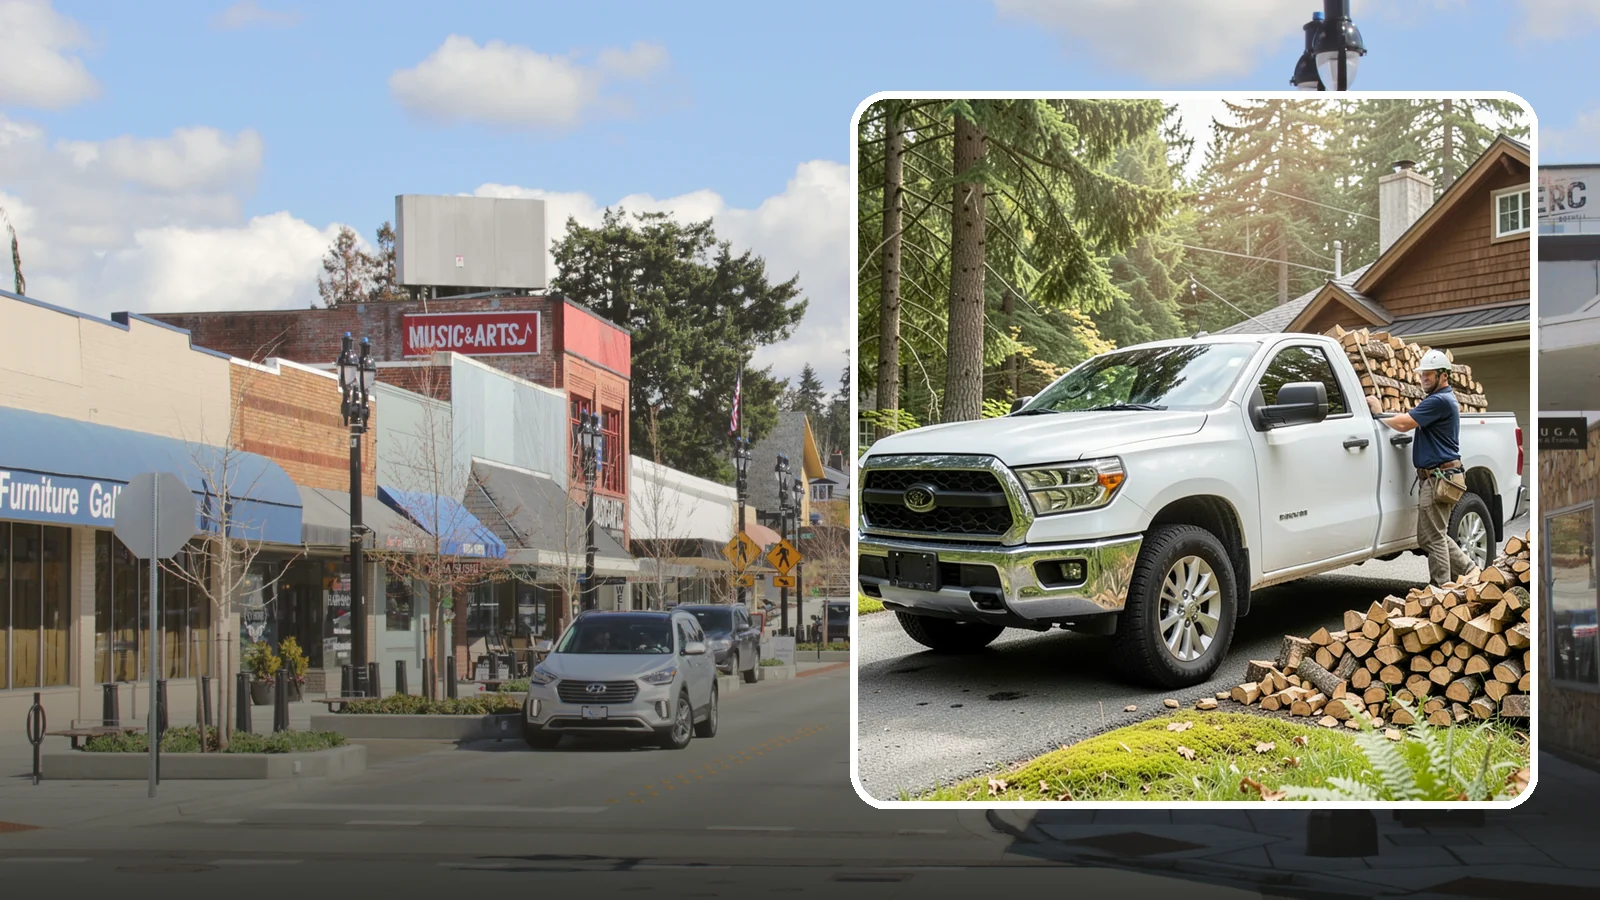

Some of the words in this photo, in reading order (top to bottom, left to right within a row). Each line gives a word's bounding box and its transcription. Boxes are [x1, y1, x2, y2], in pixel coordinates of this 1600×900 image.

[408, 322, 520, 349] MUSIC&ARTS
[1540, 427, 1578, 437] UGA
[0, 470, 79, 515] Furniture
[89, 482, 122, 519] Gal
